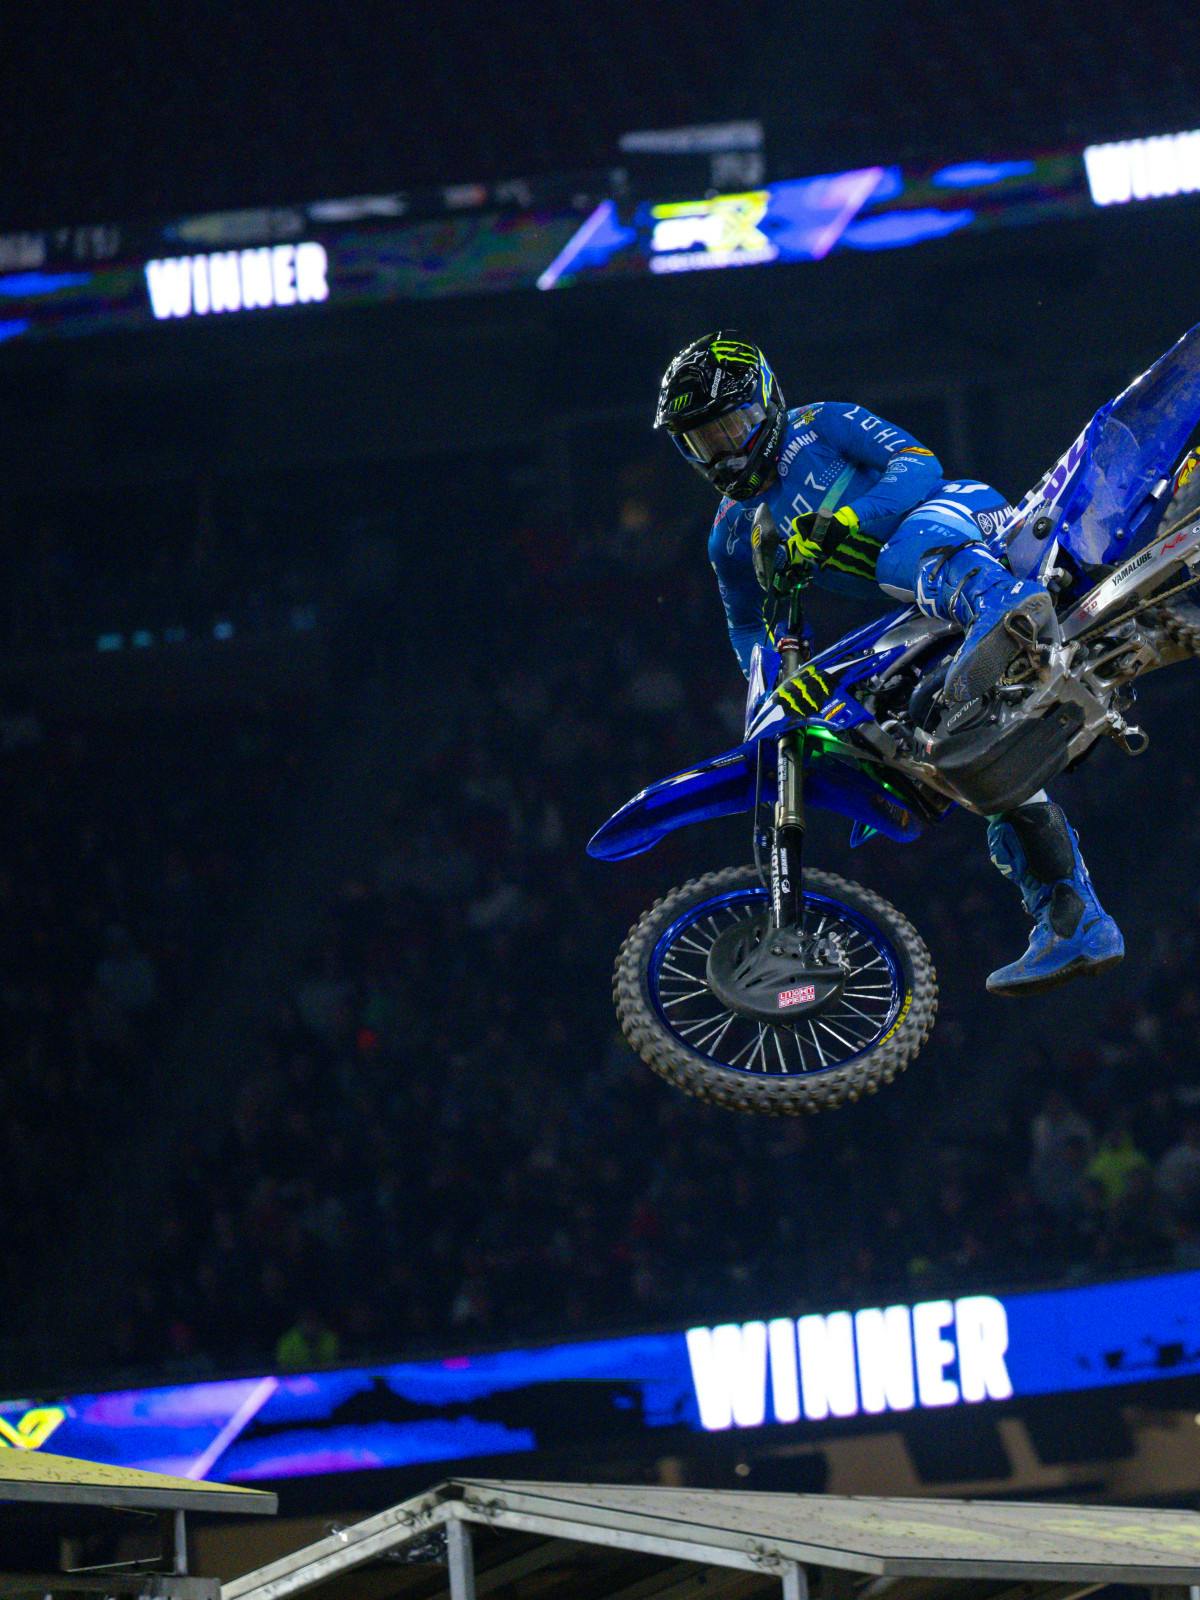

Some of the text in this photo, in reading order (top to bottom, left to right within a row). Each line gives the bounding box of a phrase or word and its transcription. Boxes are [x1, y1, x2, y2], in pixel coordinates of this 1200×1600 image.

[146, 241, 328, 319] WINNER
[781, 429, 819, 466] YAMAHA
[1111, 550, 1153, 587] YAMALUBE
[686, 1294, 1013, 1431] WINNER
